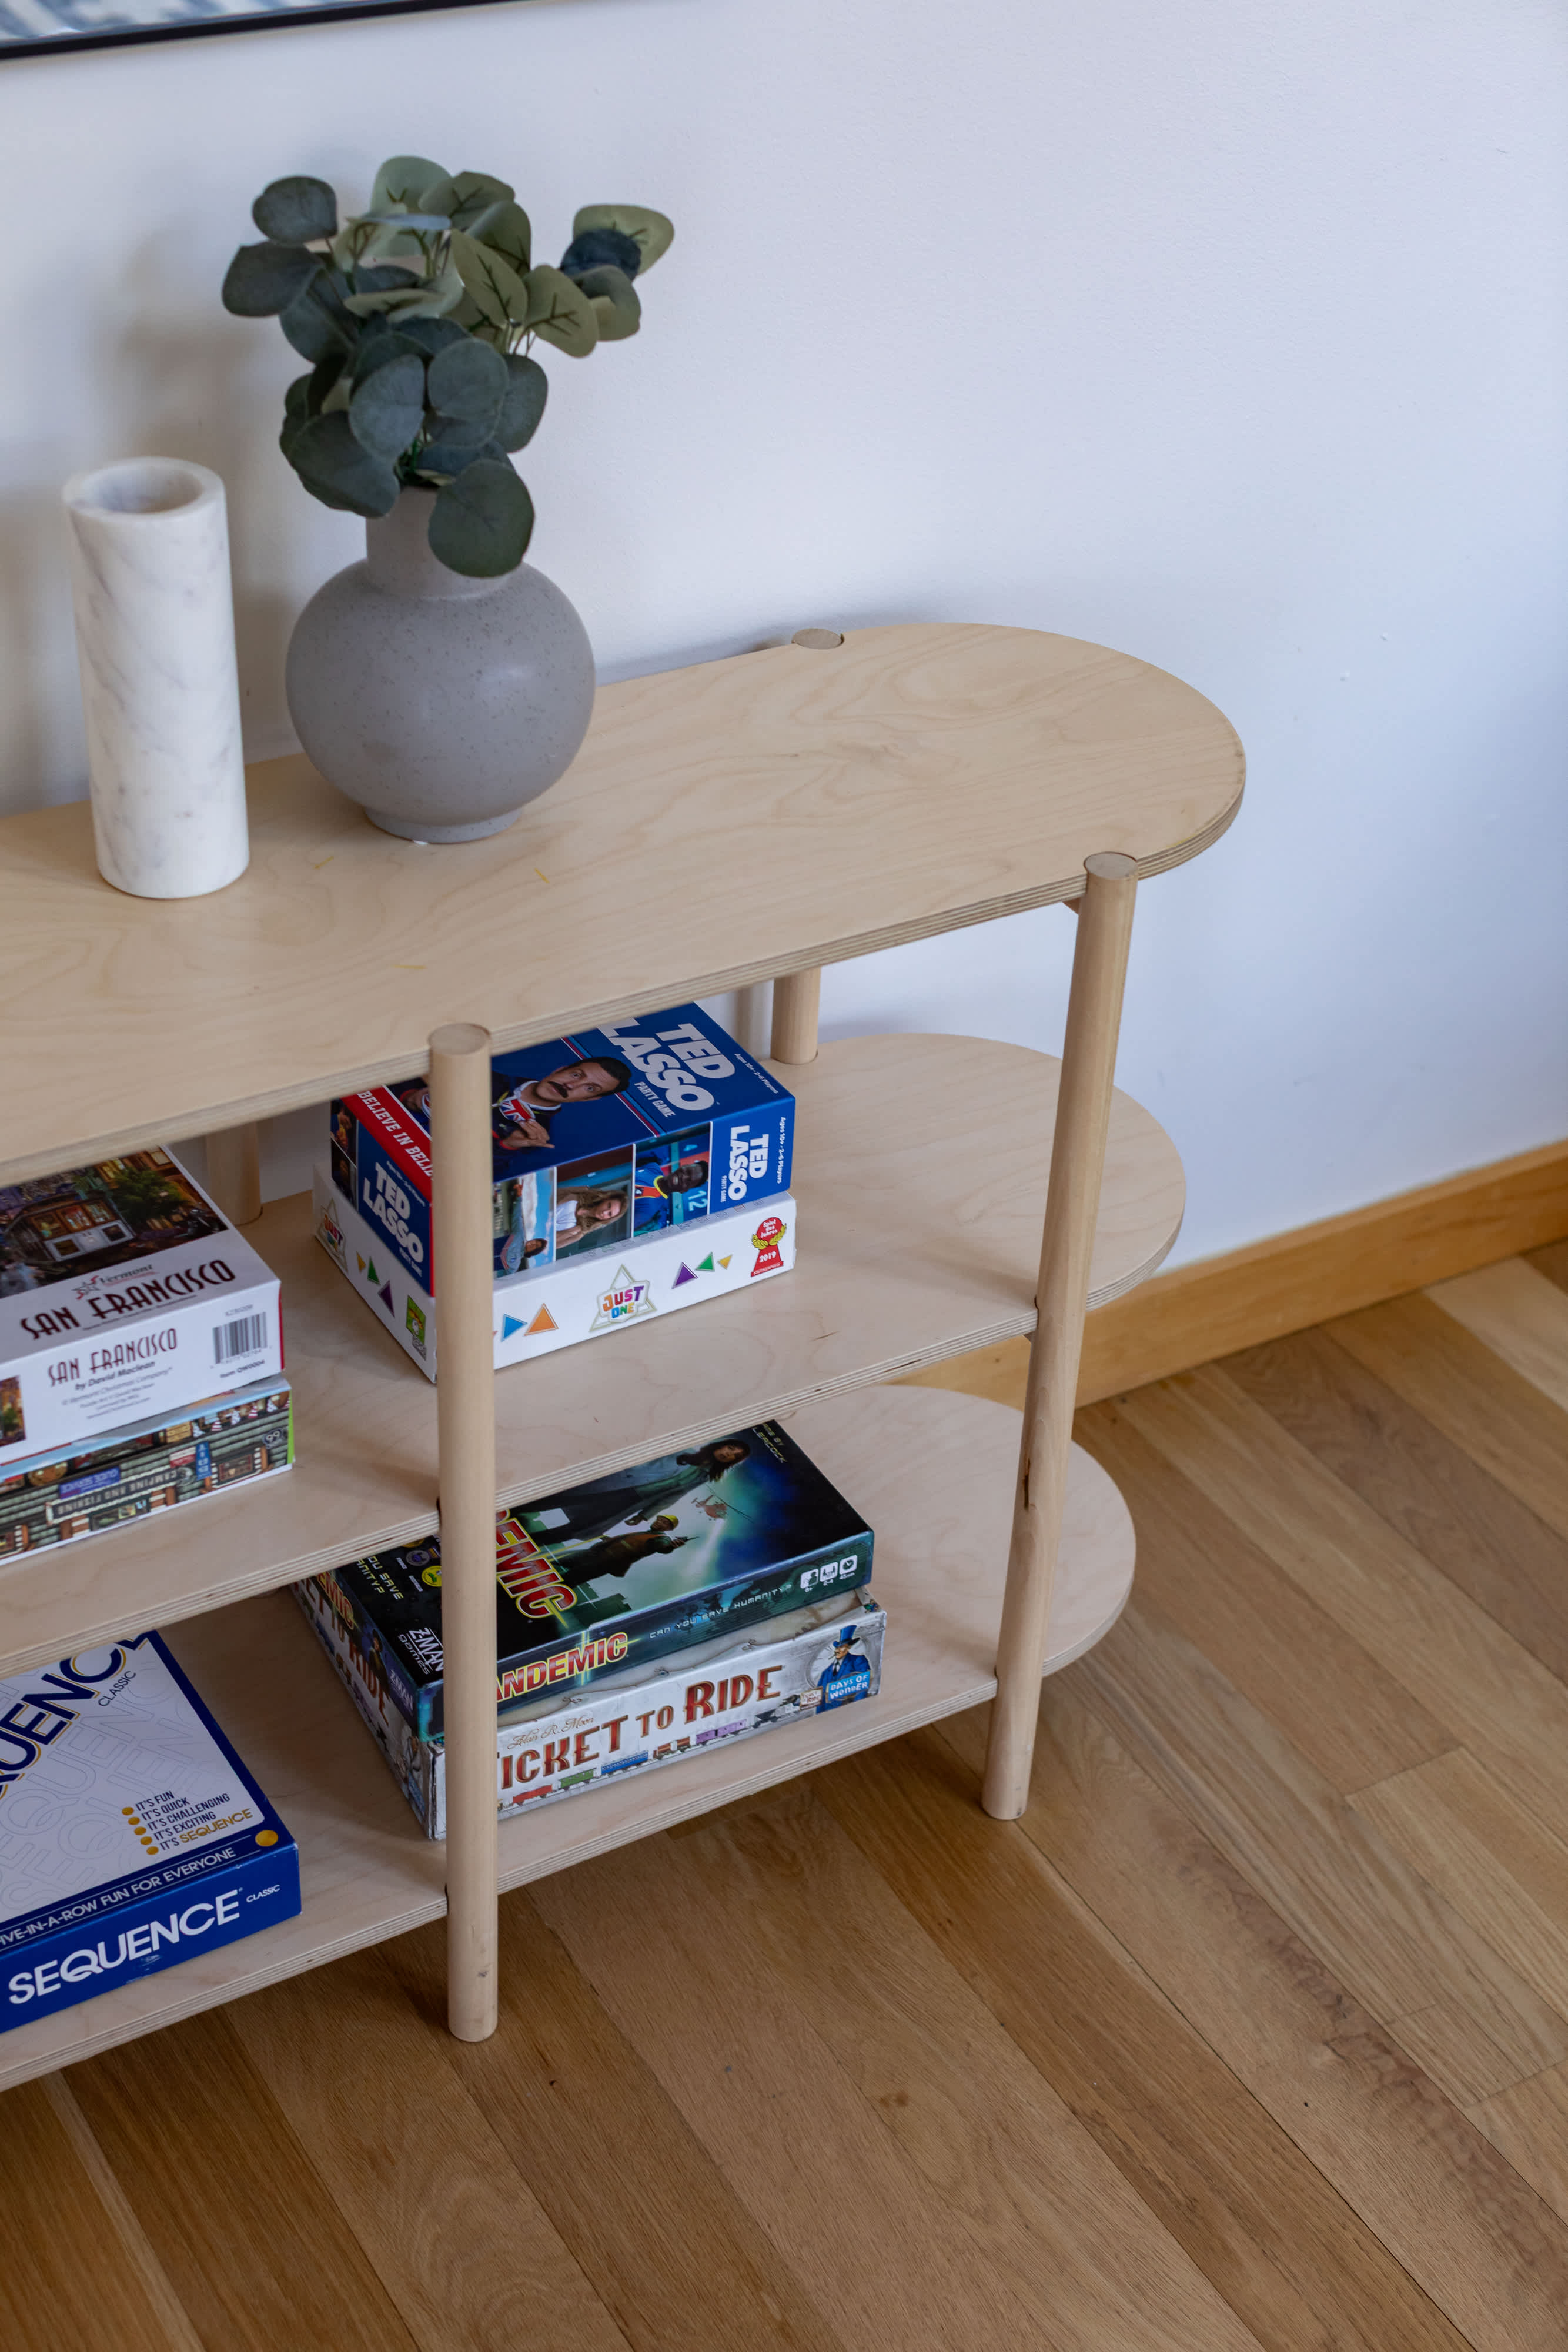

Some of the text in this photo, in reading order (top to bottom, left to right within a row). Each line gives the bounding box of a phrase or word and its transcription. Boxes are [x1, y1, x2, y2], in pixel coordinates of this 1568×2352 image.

[597, 1017, 715, 1111] LASSO
[656, 1023, 735, 1078] TED
[357, 1091, 402, 1132] BELIEVE
[393, 1132, 414, 1145] IN
[634, 1081, 676, 1117] PARTY GAME
[728, 1125, 750, 1200] LASSO
[749, 1134, 769, 1178] TED
[375, 1162, 410, 1220] TED
[688, 1190, 707, 1211] 12
[363, 1177, 424, 1263] LASSO
[99, 1264, 153, 1284] Vermont
[759, 1251, 777, 1263] 2019
[21, 1307, 81, 1340] SAN
[87, 1259, 236, 1319] FRANCISCO
[603, 1285, 645, 1312] JUST
[611, 1302, 634, 1318] ONE
[48, 1358, 81, 1387] SAN
[89, 1328, 177, 1374] FRANCISCO
[129, 1471, 176, 1493] CAMPING
[356, 1559, 386, 1595] ANITY?
[367, 1556, 383, 1570] OU
[380, 1572, 404, 1600] SAVE
[650, 1584, 792, 1639] CAN YOU SAVE HUMANITY?
[398, 1634, 430, 1675] games
[98, 1670, 136, 1707] CLASSIC
[830, 1674, 868, 1691] DAYS OF
[0, 1630, 152, 1799] UENC
[497, 1665, 783, 1789] ICKET TO RIDE
[507, 1728, 540, 1750] Alan
[561, 1715, 594, 1733] Moon
[135, 1790, 175, 1811] IT'S FUN
[141, 1797, 191, 1821] IT'S QUICK
[147, 1793, 230, 1831] IT'S CHALLENGING
[153, 1811, 216, 1841] IT'S EXCITING
[159, 1808, 253, 1850] IT'S SEQUENCE
[0, 1847, 237, 1946] IVE-IN-A-ROW FUN FOR EVERYONE
[246, 1884, 280, 1903] CLASSIC
[8, 1889, 240, 2004] SEQUENCE
